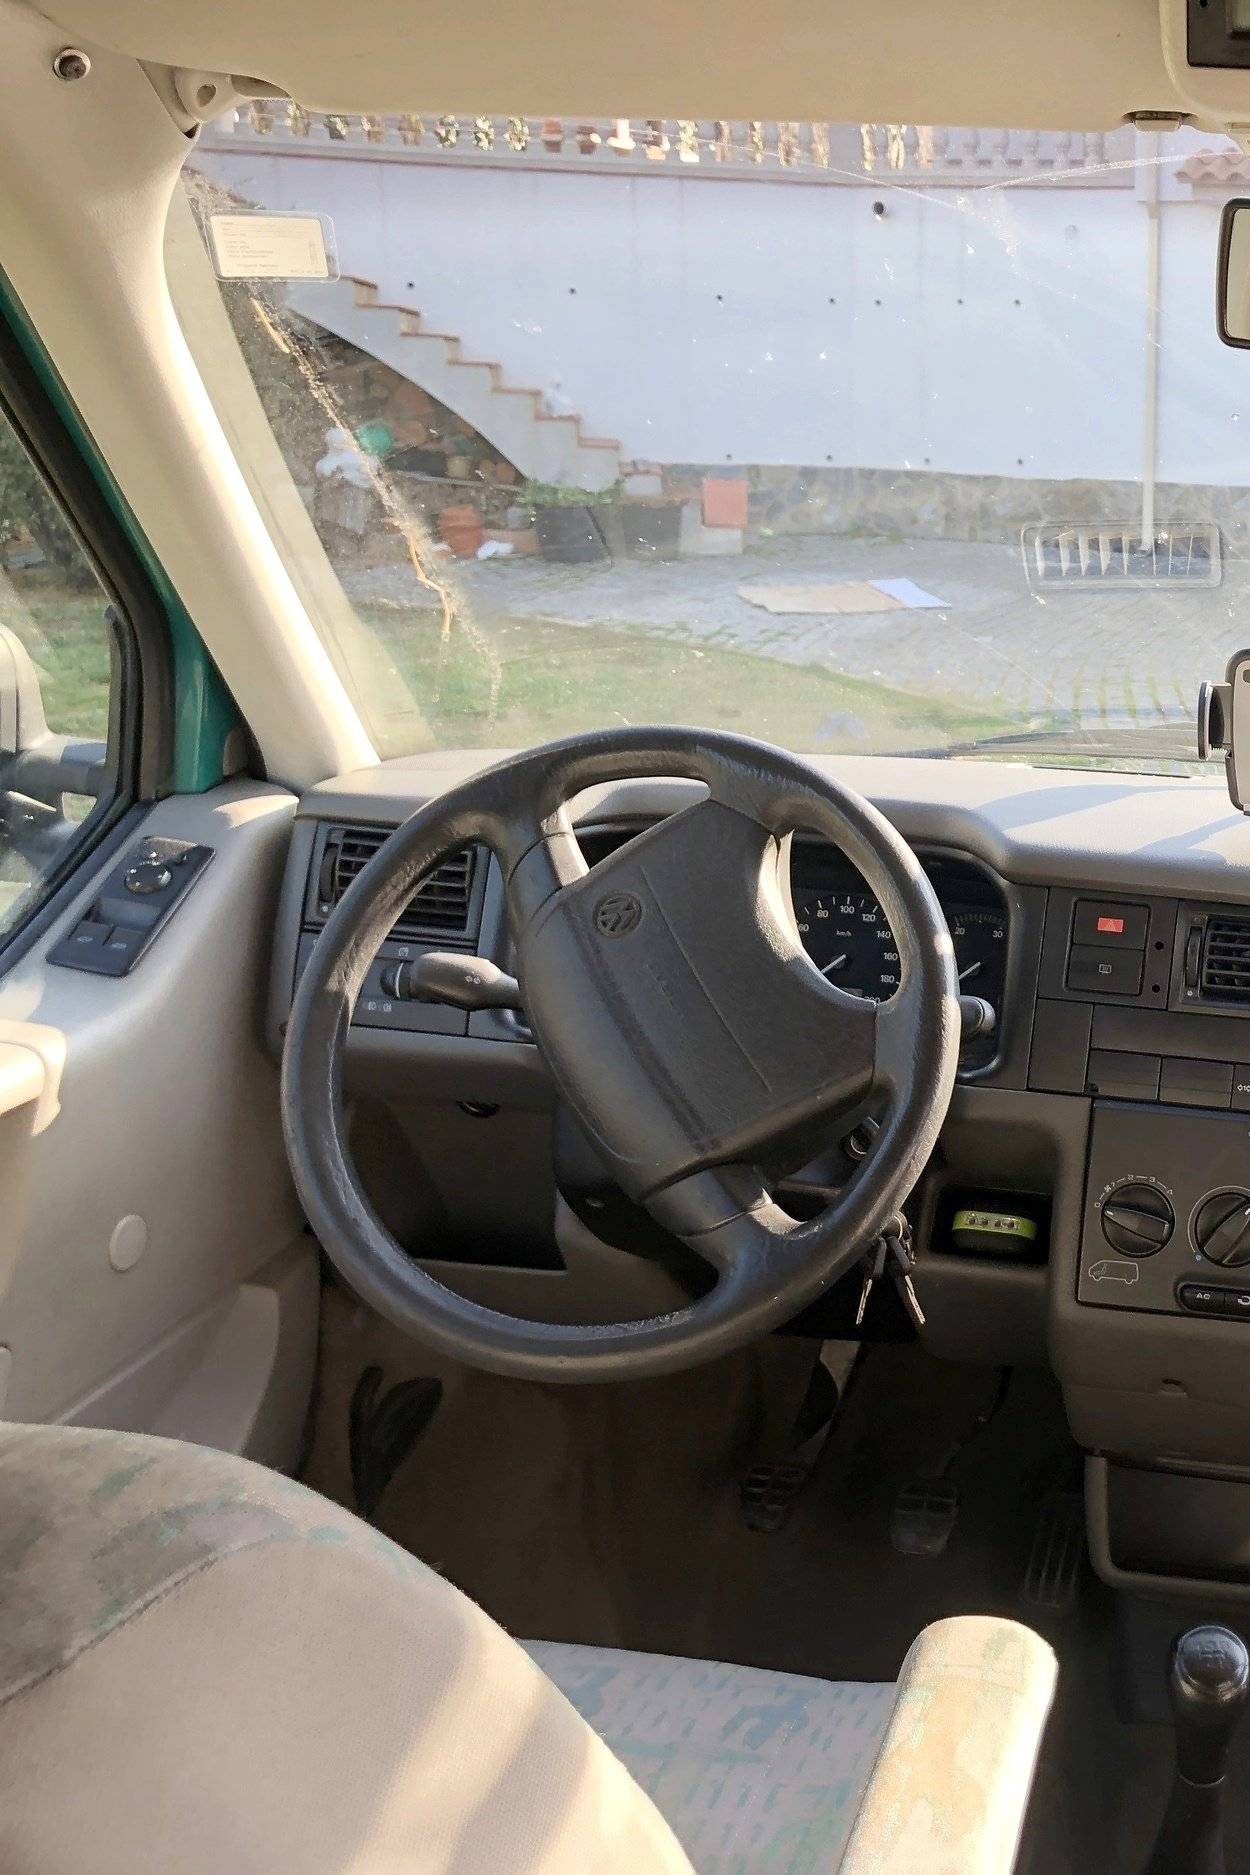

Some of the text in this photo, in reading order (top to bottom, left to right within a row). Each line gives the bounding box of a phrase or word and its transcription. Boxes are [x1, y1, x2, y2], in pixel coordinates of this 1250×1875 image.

[816, 909, 829, 918] 80
[840, 905, 855, 914] 100
[861, 913, 876, 922] 120
[876, 930, 891, 939] 140
[955, 927, 966, 936] 20
[992, 930, 1003, 939] 30
[883, 952, 898, 961] 160
[880, 974, 895, 983] 180
